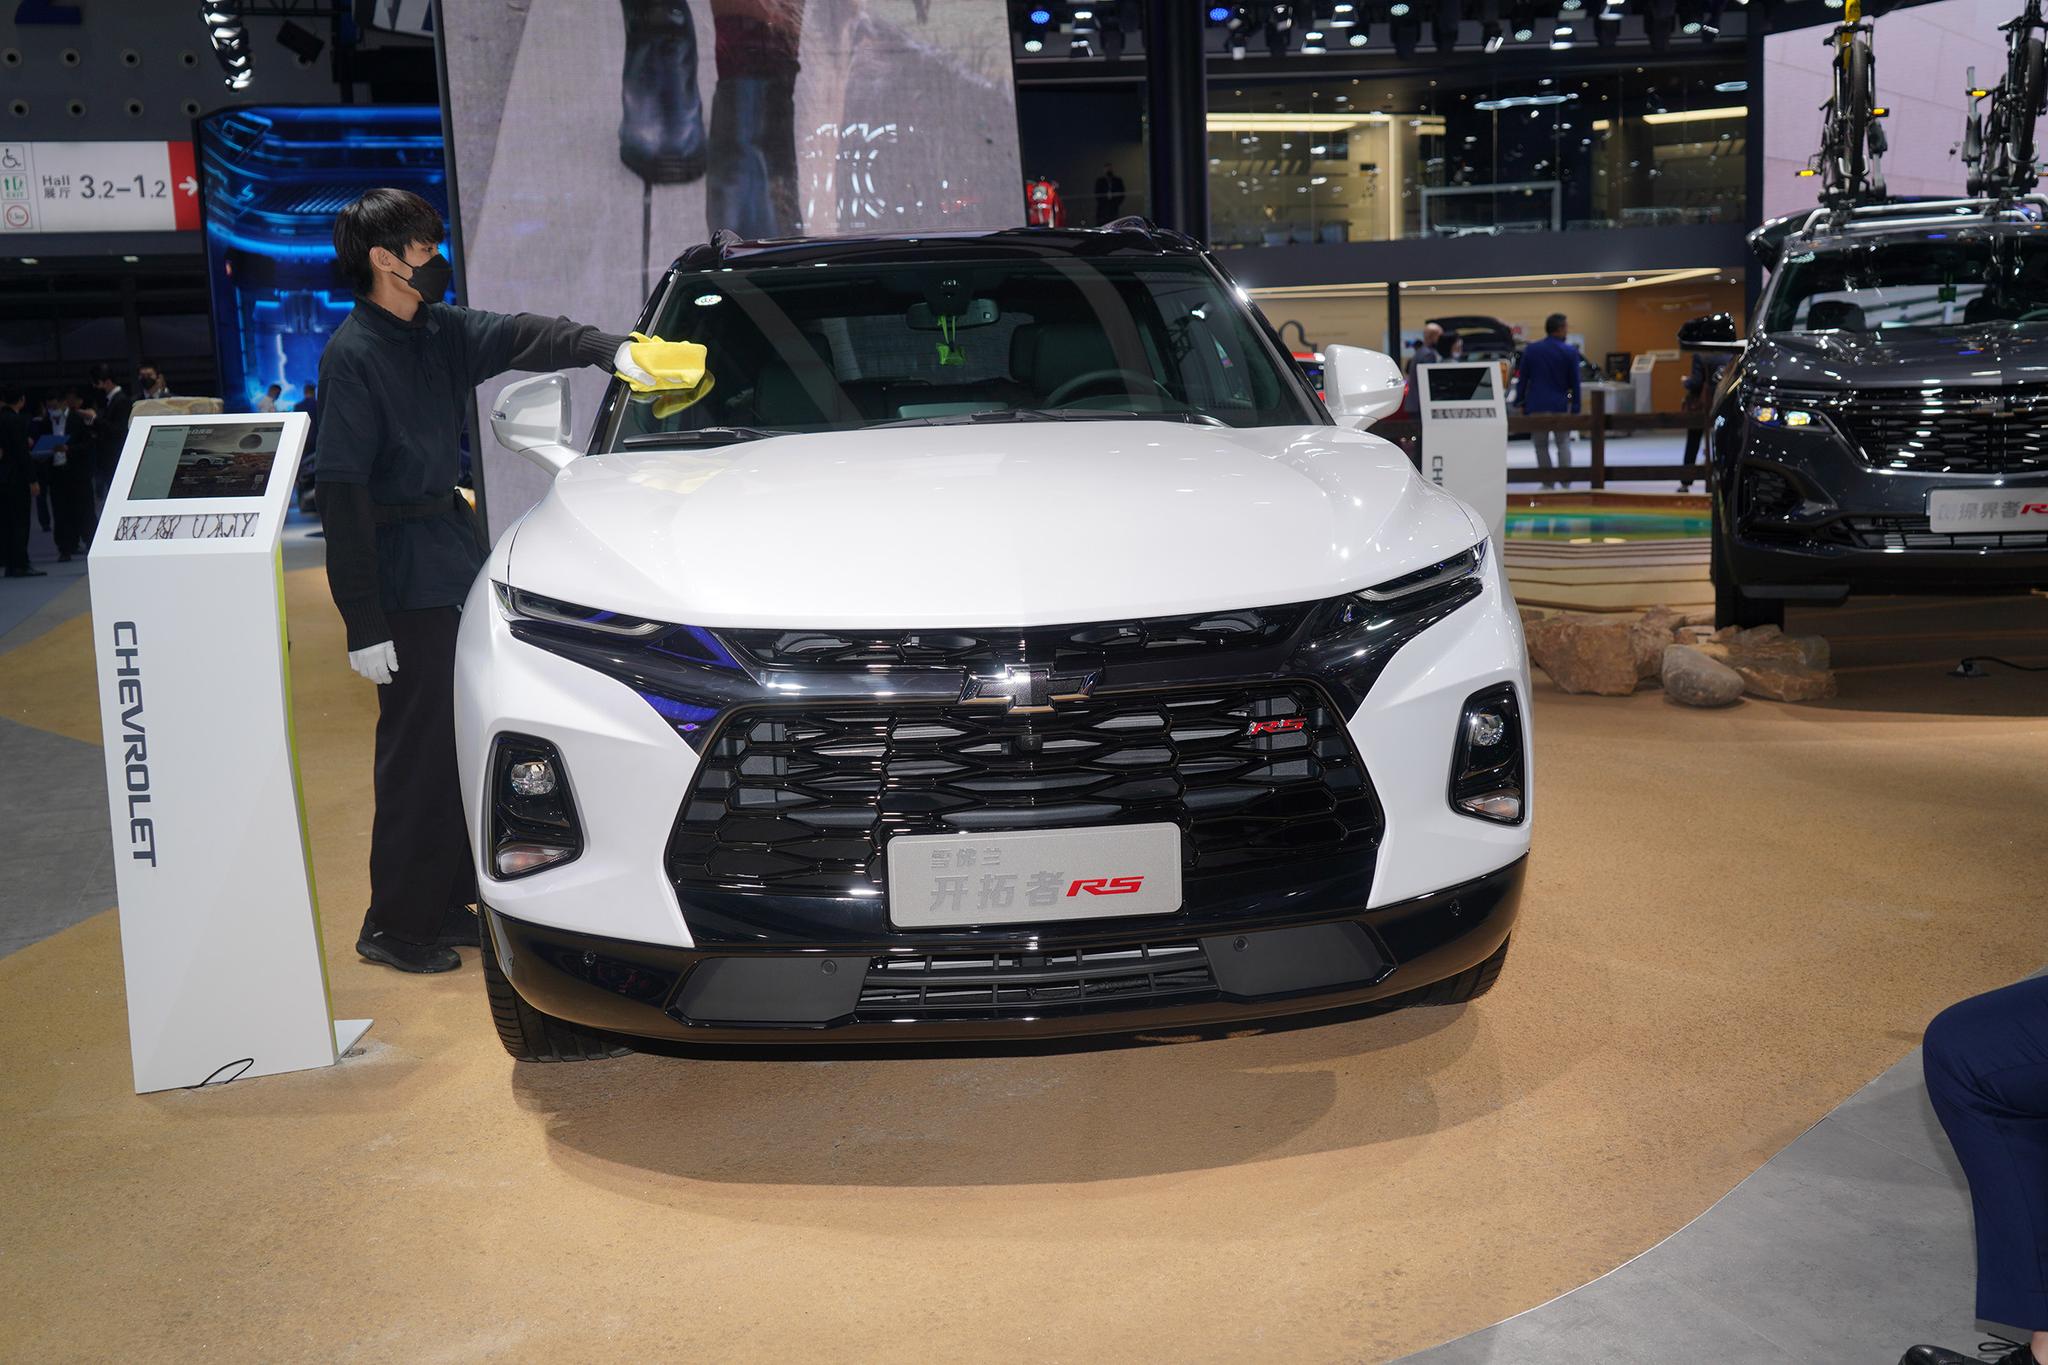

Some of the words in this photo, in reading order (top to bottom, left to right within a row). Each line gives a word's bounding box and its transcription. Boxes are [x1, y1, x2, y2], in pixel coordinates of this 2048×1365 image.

[42, 175, 71, 187] Hall
[44, 187, 72, 199] 展厅
[1432, 456, 1444, 486] CH
[2020, 503, 2048, 515] R
[1246, 717, 1308, 735] RS
[113, 621, 157, 867] CHEVROLET
[930, 871, 1064, 912] 开拓者
[1066, 875, 1145, 897] RS
